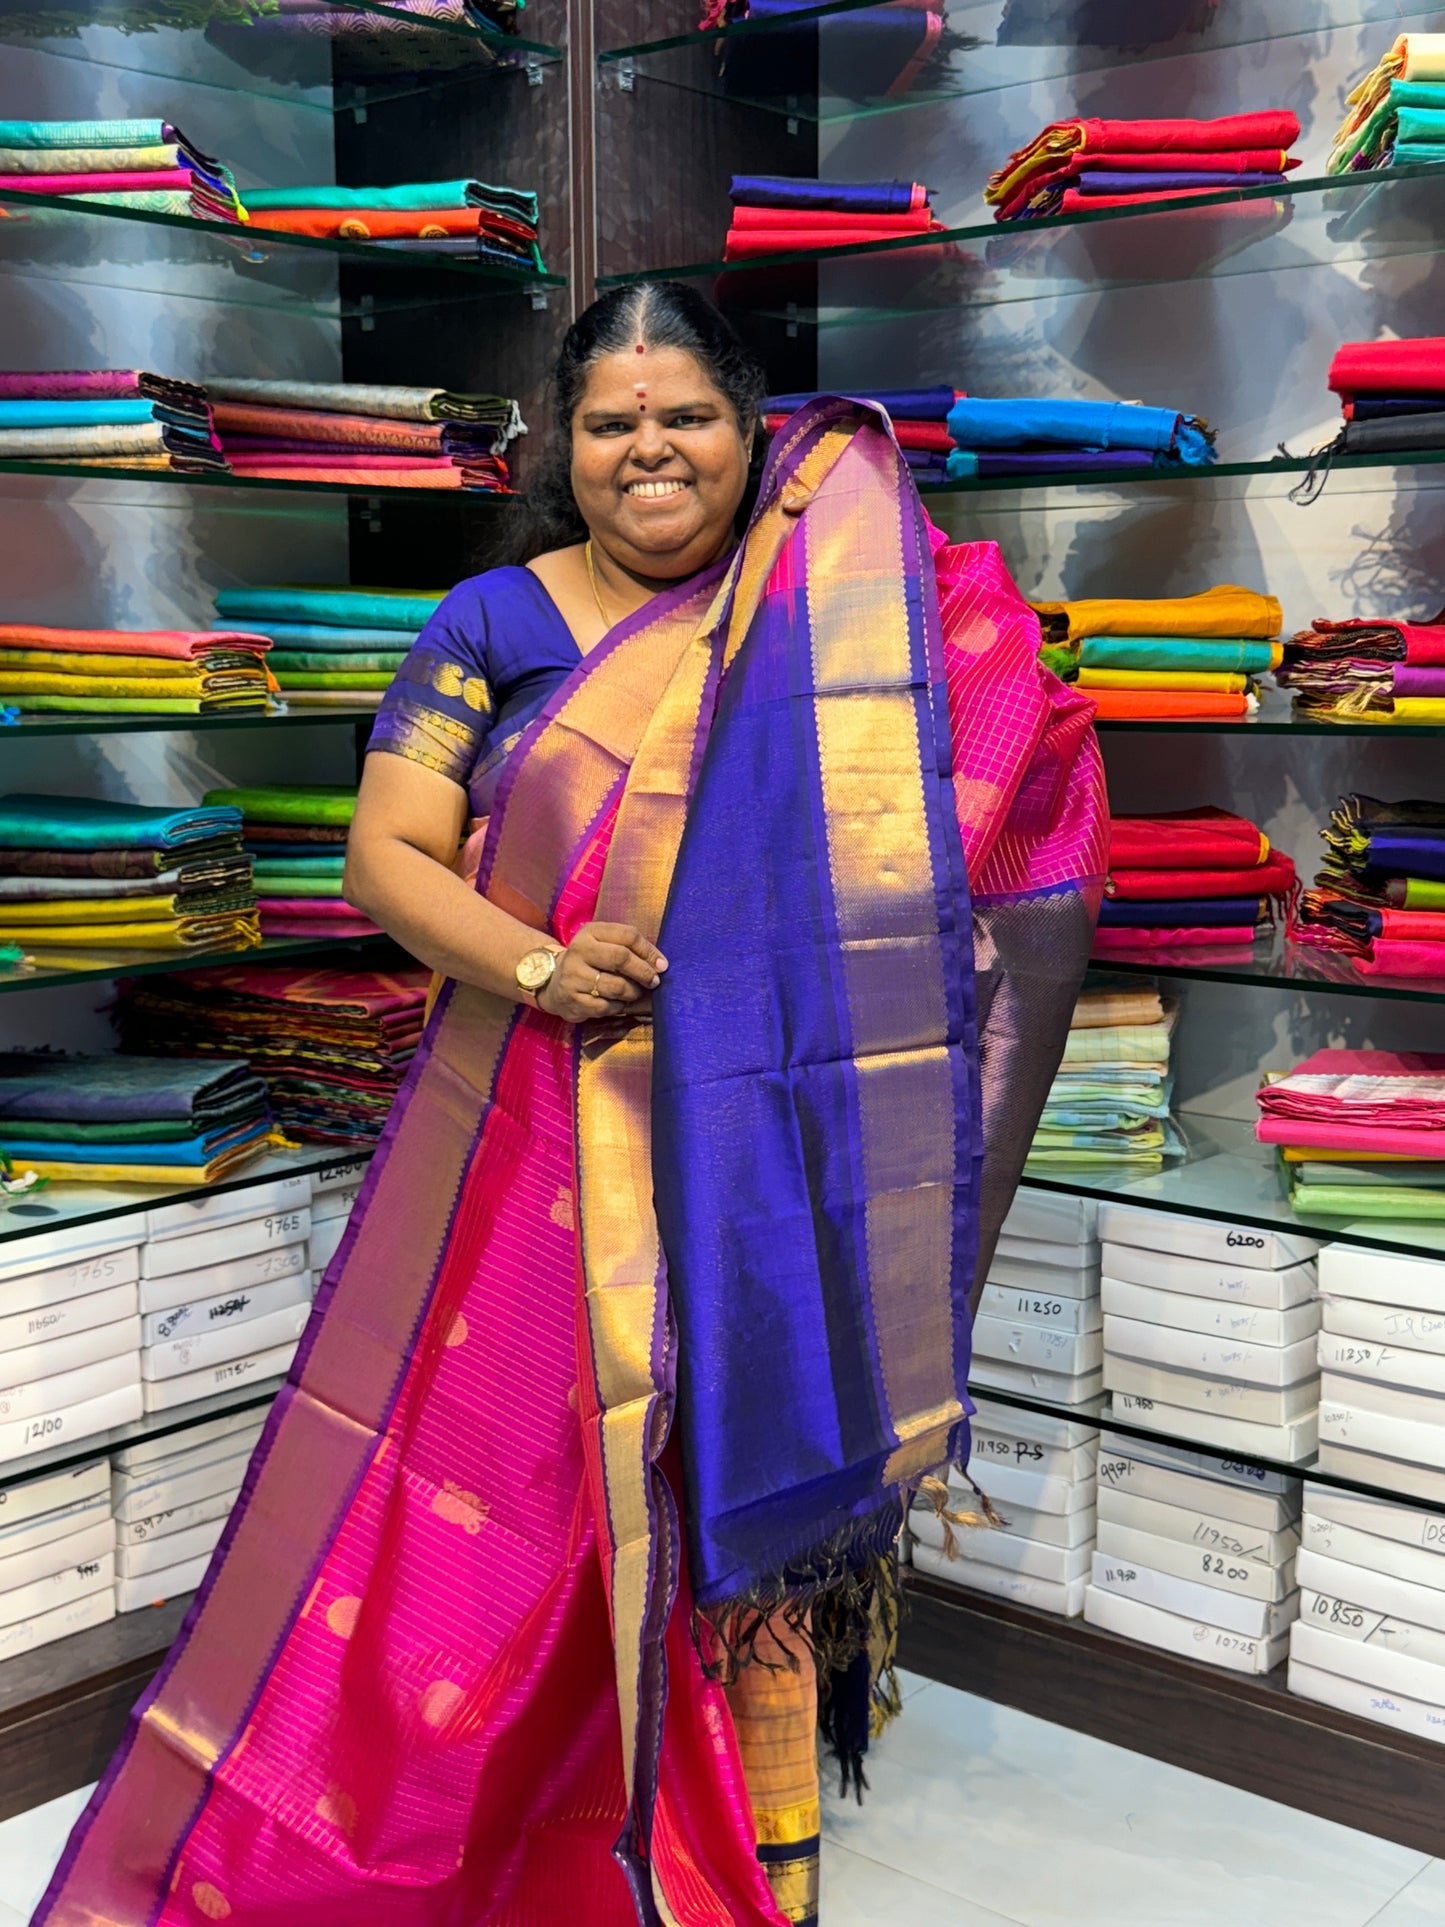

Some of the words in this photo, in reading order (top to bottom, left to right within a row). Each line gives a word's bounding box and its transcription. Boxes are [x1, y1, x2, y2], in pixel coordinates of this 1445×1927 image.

[264, 1215, 300, 1238] 9765
[1226, 1230, 1265, 1249] 6200
[66, 1257, 123, 1287] 9765
[1017, 1296, 1062, 1315] 11250
[976, 1439, 1010, 1455] 11.950
[1193, 1522, 1270, 1565] 11950/-
[1202, 1553, 1249, 1581] 8200
[1215, 1633, 1257, 1656] 10725
